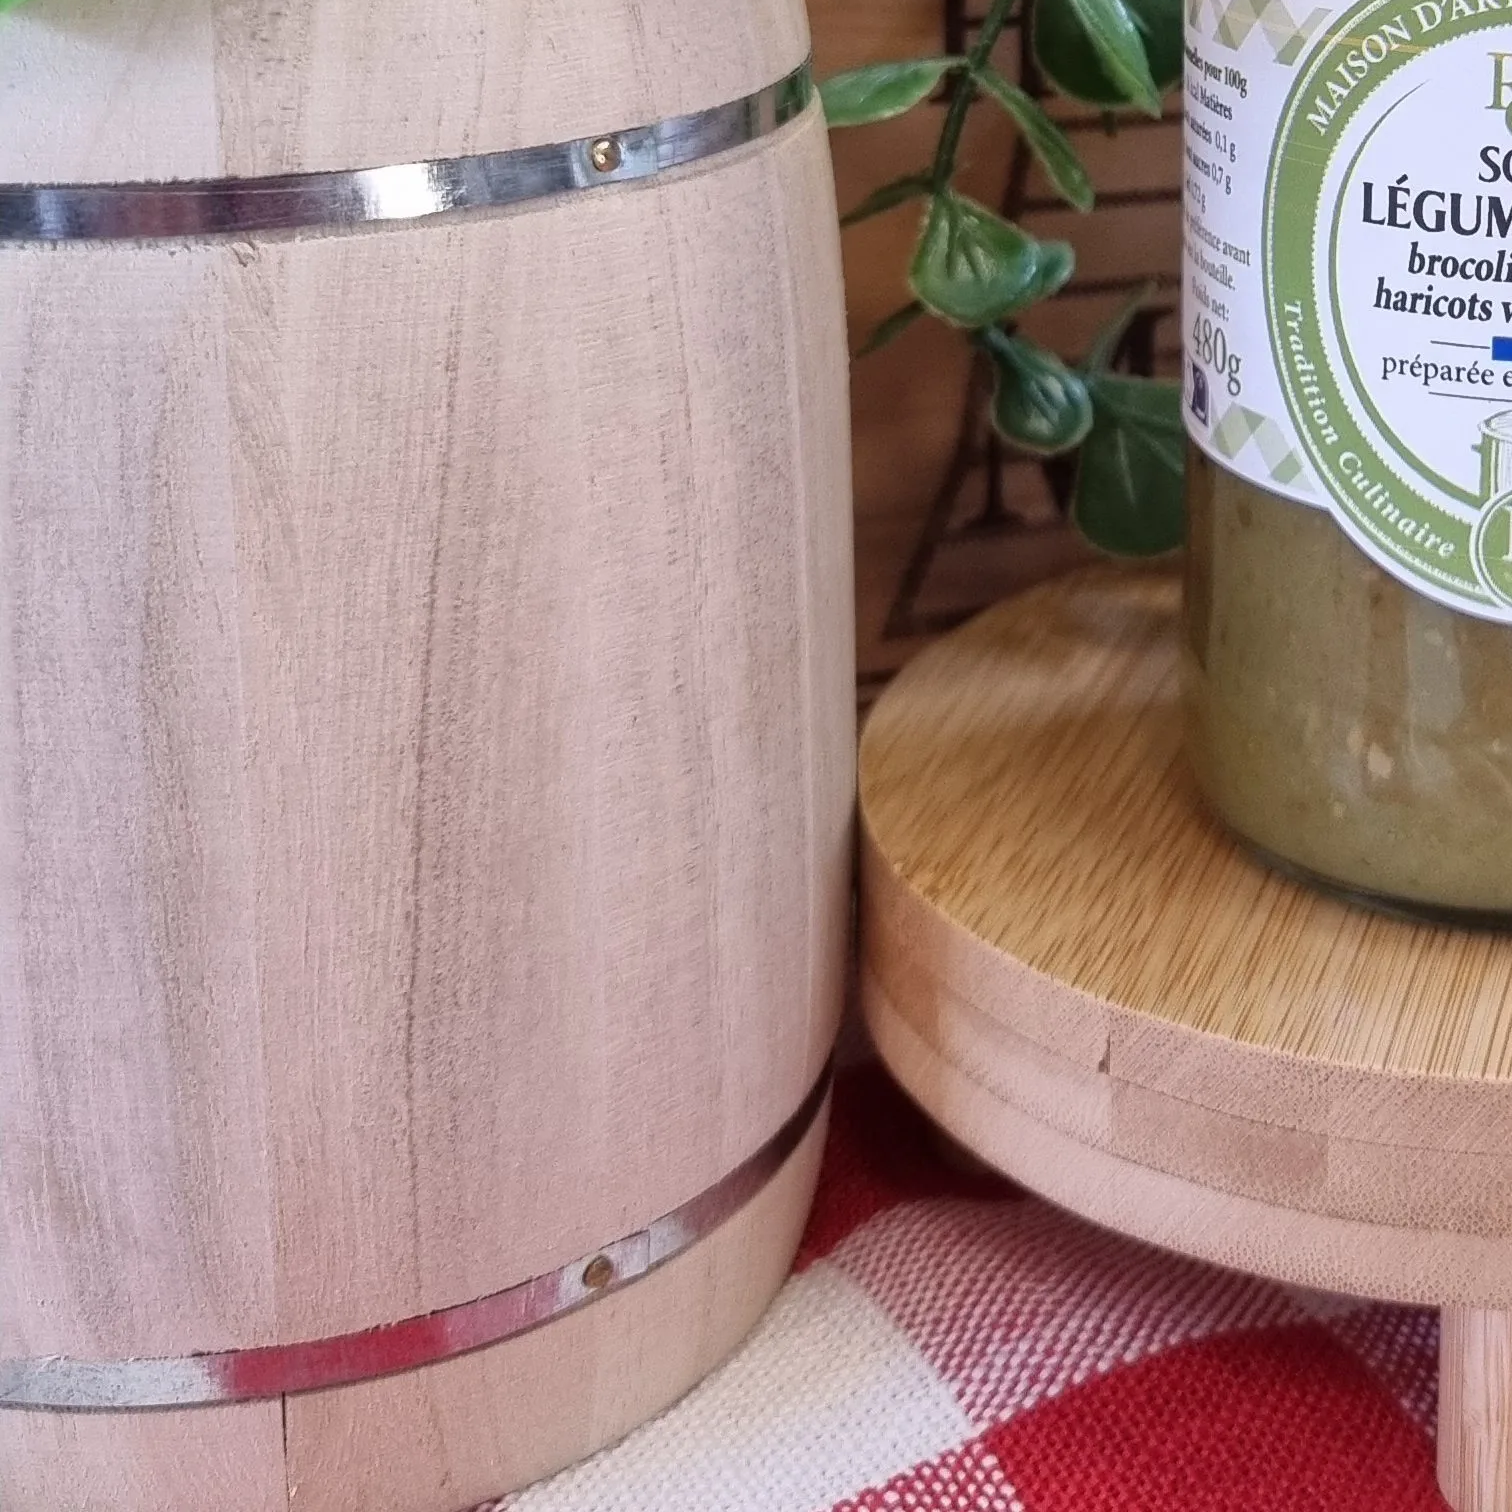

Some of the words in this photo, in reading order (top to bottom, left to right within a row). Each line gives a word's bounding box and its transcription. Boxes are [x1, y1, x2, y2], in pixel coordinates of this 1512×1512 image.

[1204, 61, 1222, 81] pour
[1224, 65, 1247, 99] 100g
[1306, 15, 1412, 136] MAISON
[1200, 85, 1233, 120] Matières
[1215, 129, 1227, 153] 0,1
[1212, 162, 1223, 184] 0,7
[1222, 241, 1250, 266] avant
[1373, 276, 1492, 322] haricots
[1193, 311, 1241, 396] 480g
[1382, 353, 1495, 386] préparée
[1284, 300, 1339, 445] Tradition
[1338, 452, 1456, 559] Culinaire
